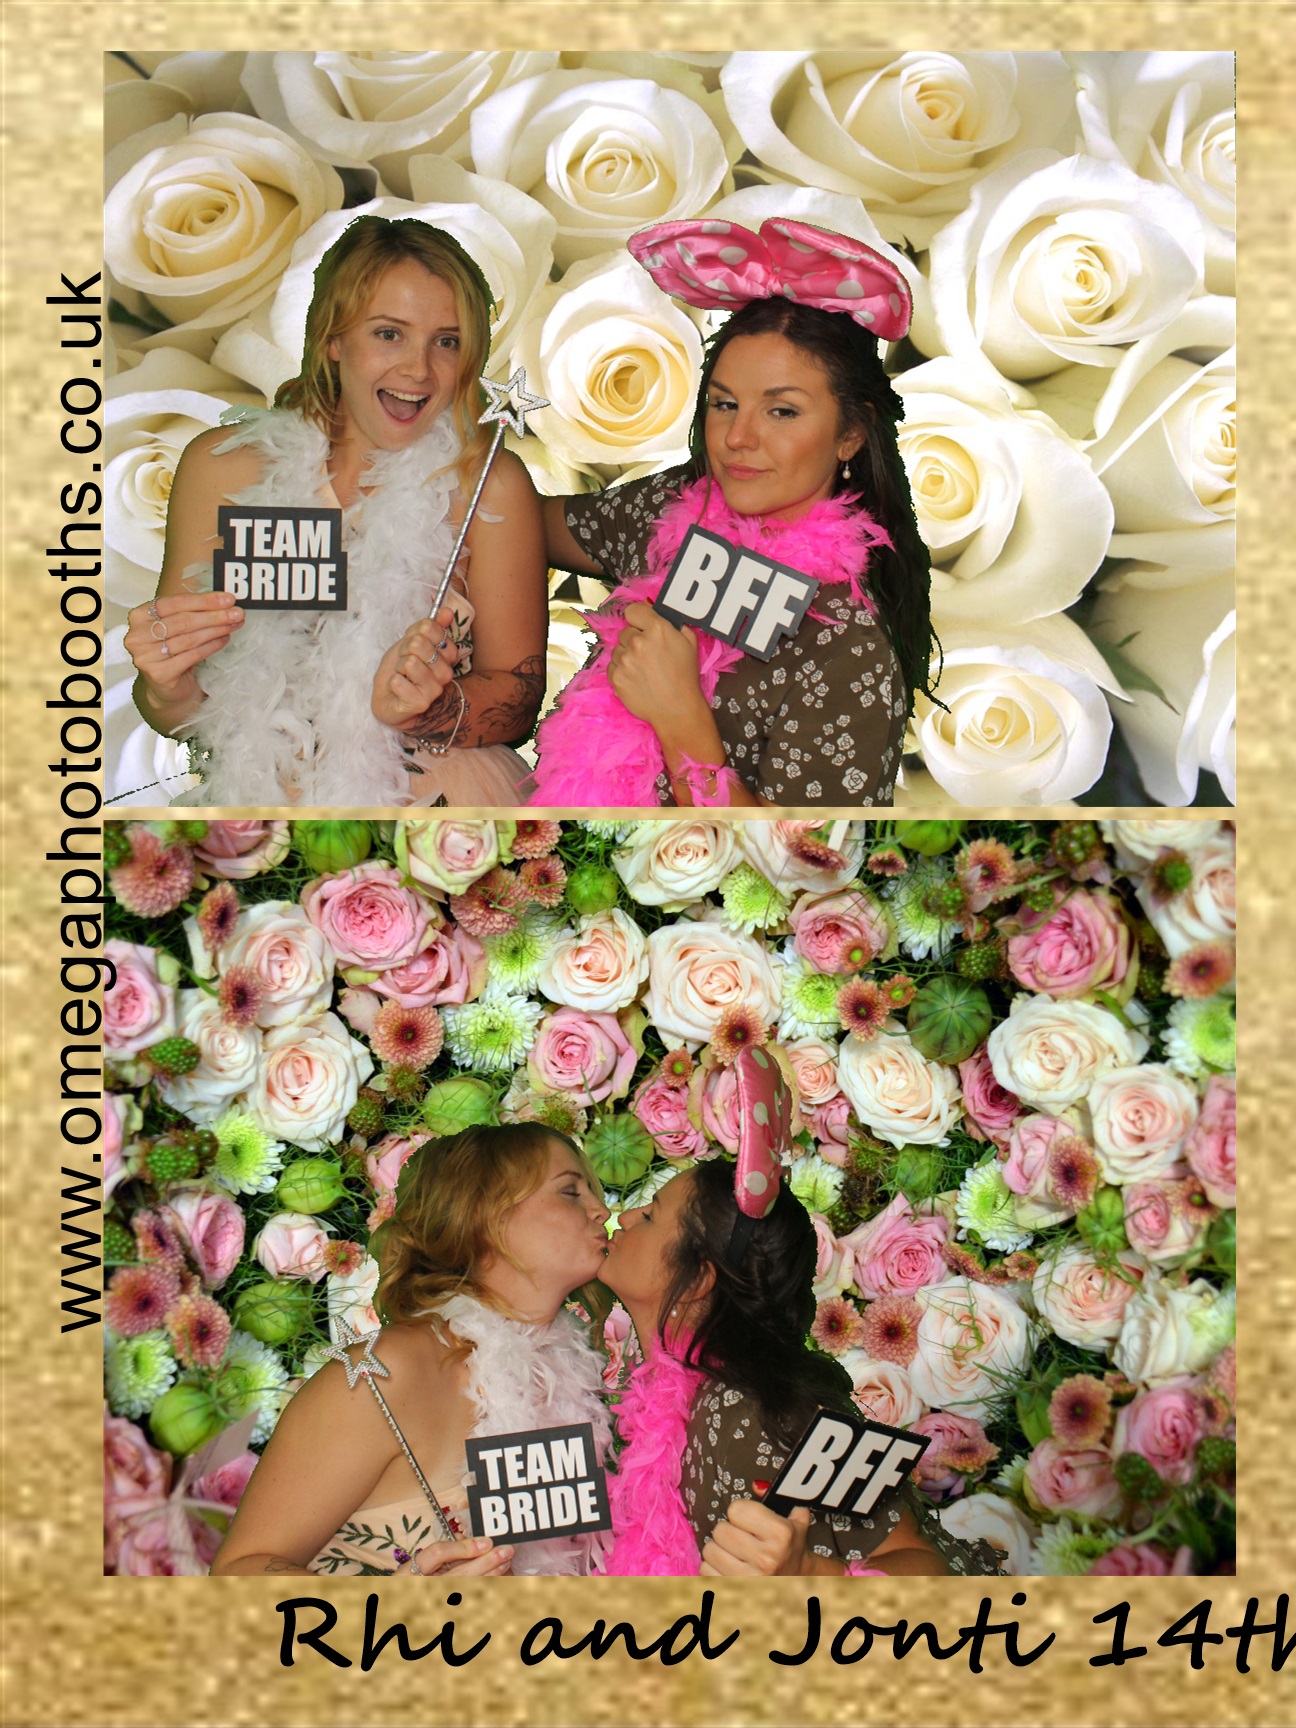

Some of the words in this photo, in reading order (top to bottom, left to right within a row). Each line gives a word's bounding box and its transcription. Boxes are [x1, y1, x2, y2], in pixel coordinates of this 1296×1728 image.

[229, 518, 332, 559] TEAM
[224, 561, 337, 602] BRIDE
[662, 533, 810, 653] BFF
[478, 1436, 587, 1491] TEAM
[776, 1416, 924, 1514] BFF
[480, 1482, 600, 1537] BRIDE
